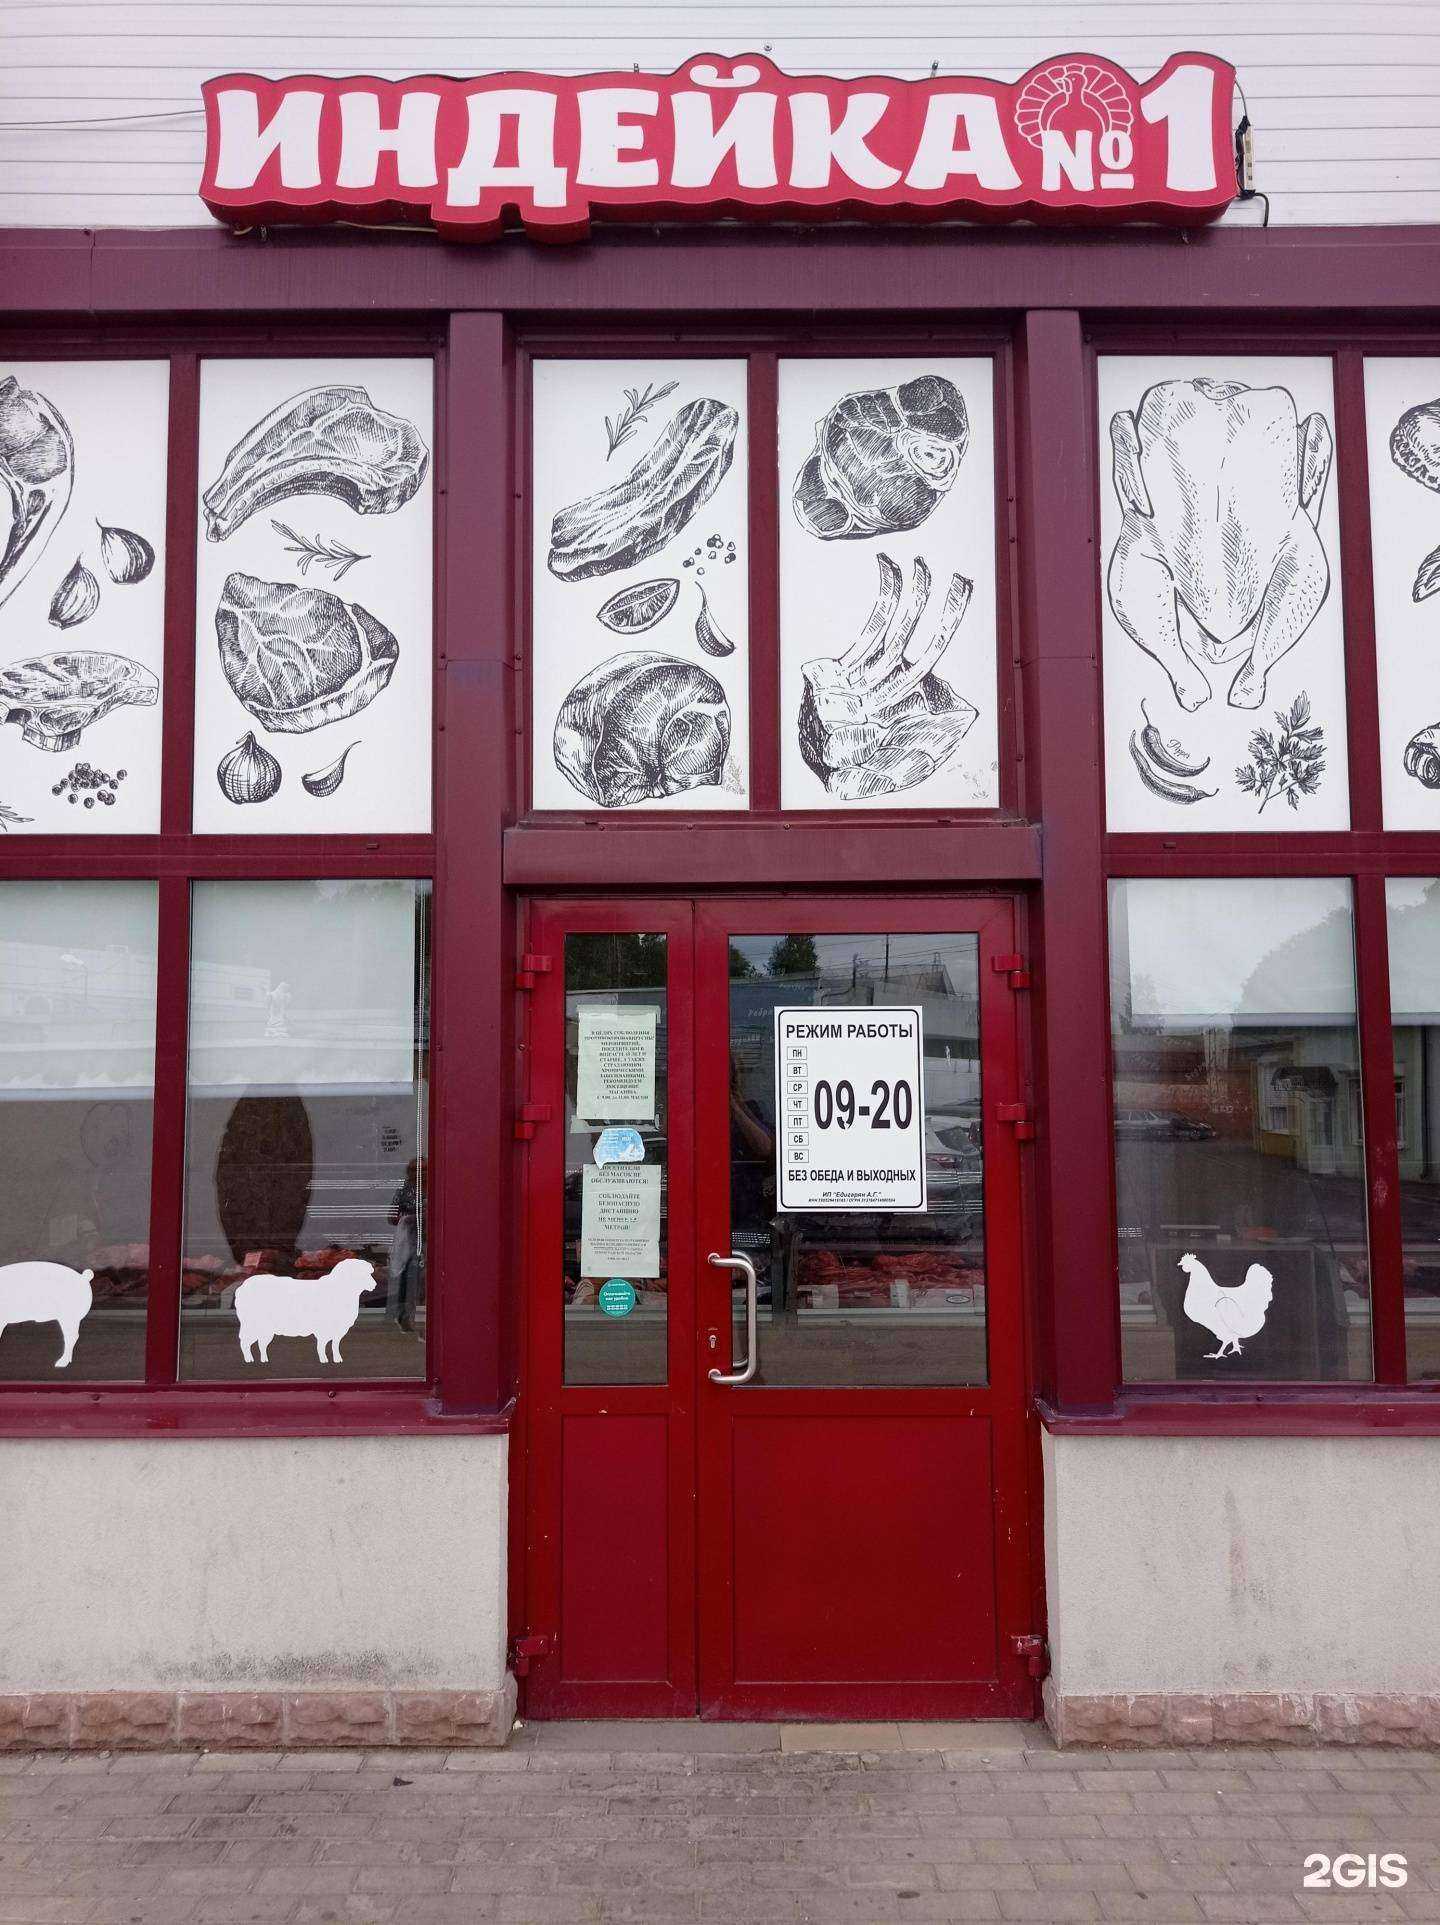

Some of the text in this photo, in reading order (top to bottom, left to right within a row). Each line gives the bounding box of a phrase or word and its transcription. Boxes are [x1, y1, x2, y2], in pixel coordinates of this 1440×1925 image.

[213, 64, 1023, 208] ИНДЕЙКА
[786, 1024, 913, 1039] РЕЖИМ РАБОТЫ
[792, 1049, 803, 1058] ПН
[792, 1066, 802, 1075] ВТ
[792, 1083, 803, 1092] СР
[793, 1100, 802, 1109] ЧТ
[814, 1079, 913, 1130] 09-20
[793, 1117, 803, 1126] ПТ
[793, 1135, 804, 1143] СБ
[794, 1152, 804, 1161] ВС
[788, 1169, 916, 1184] БЕЗ ОБЕДА И ВЫХОДНЫХ
